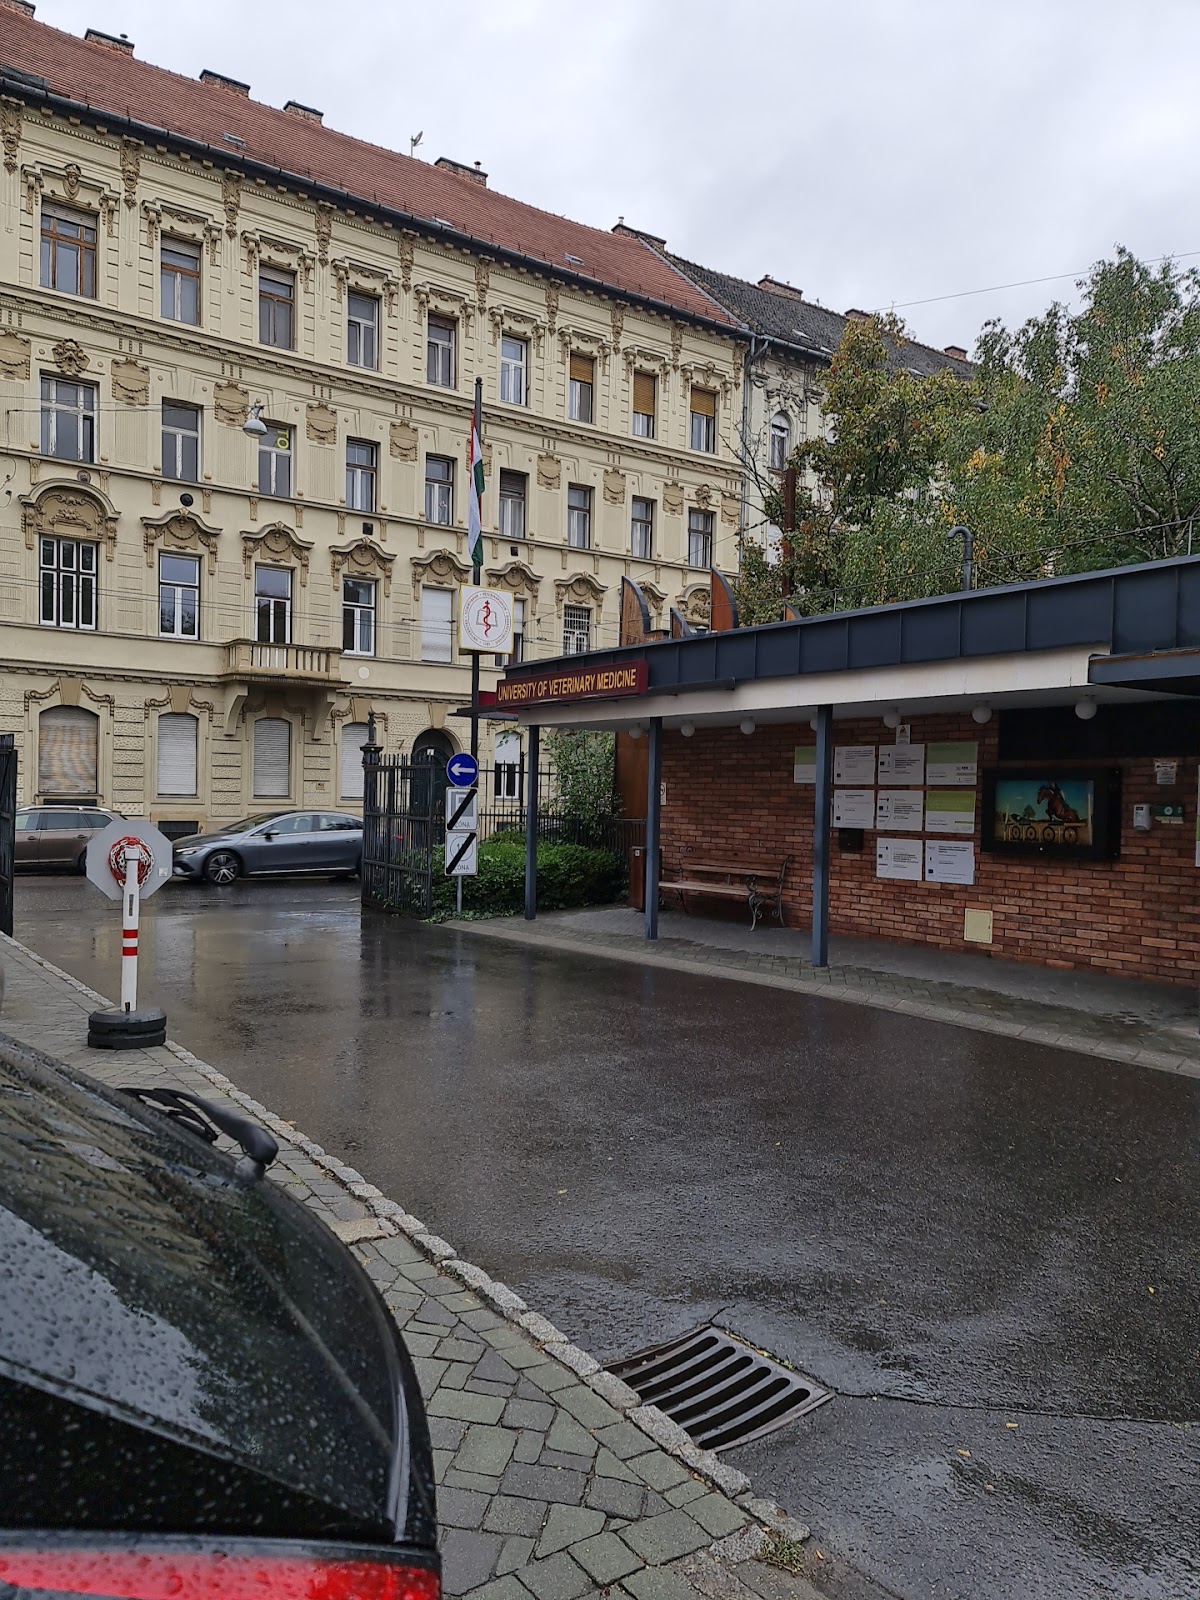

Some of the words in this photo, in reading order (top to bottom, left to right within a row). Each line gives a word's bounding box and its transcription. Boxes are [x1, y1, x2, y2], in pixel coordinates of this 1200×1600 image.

[497, 682, 537, 701] UNIVERSITY
[538, 680, 548, 697] OF
[549, 674, 596, 695] VETERINARY
[597, 669, 637, 690] MEDICINE
